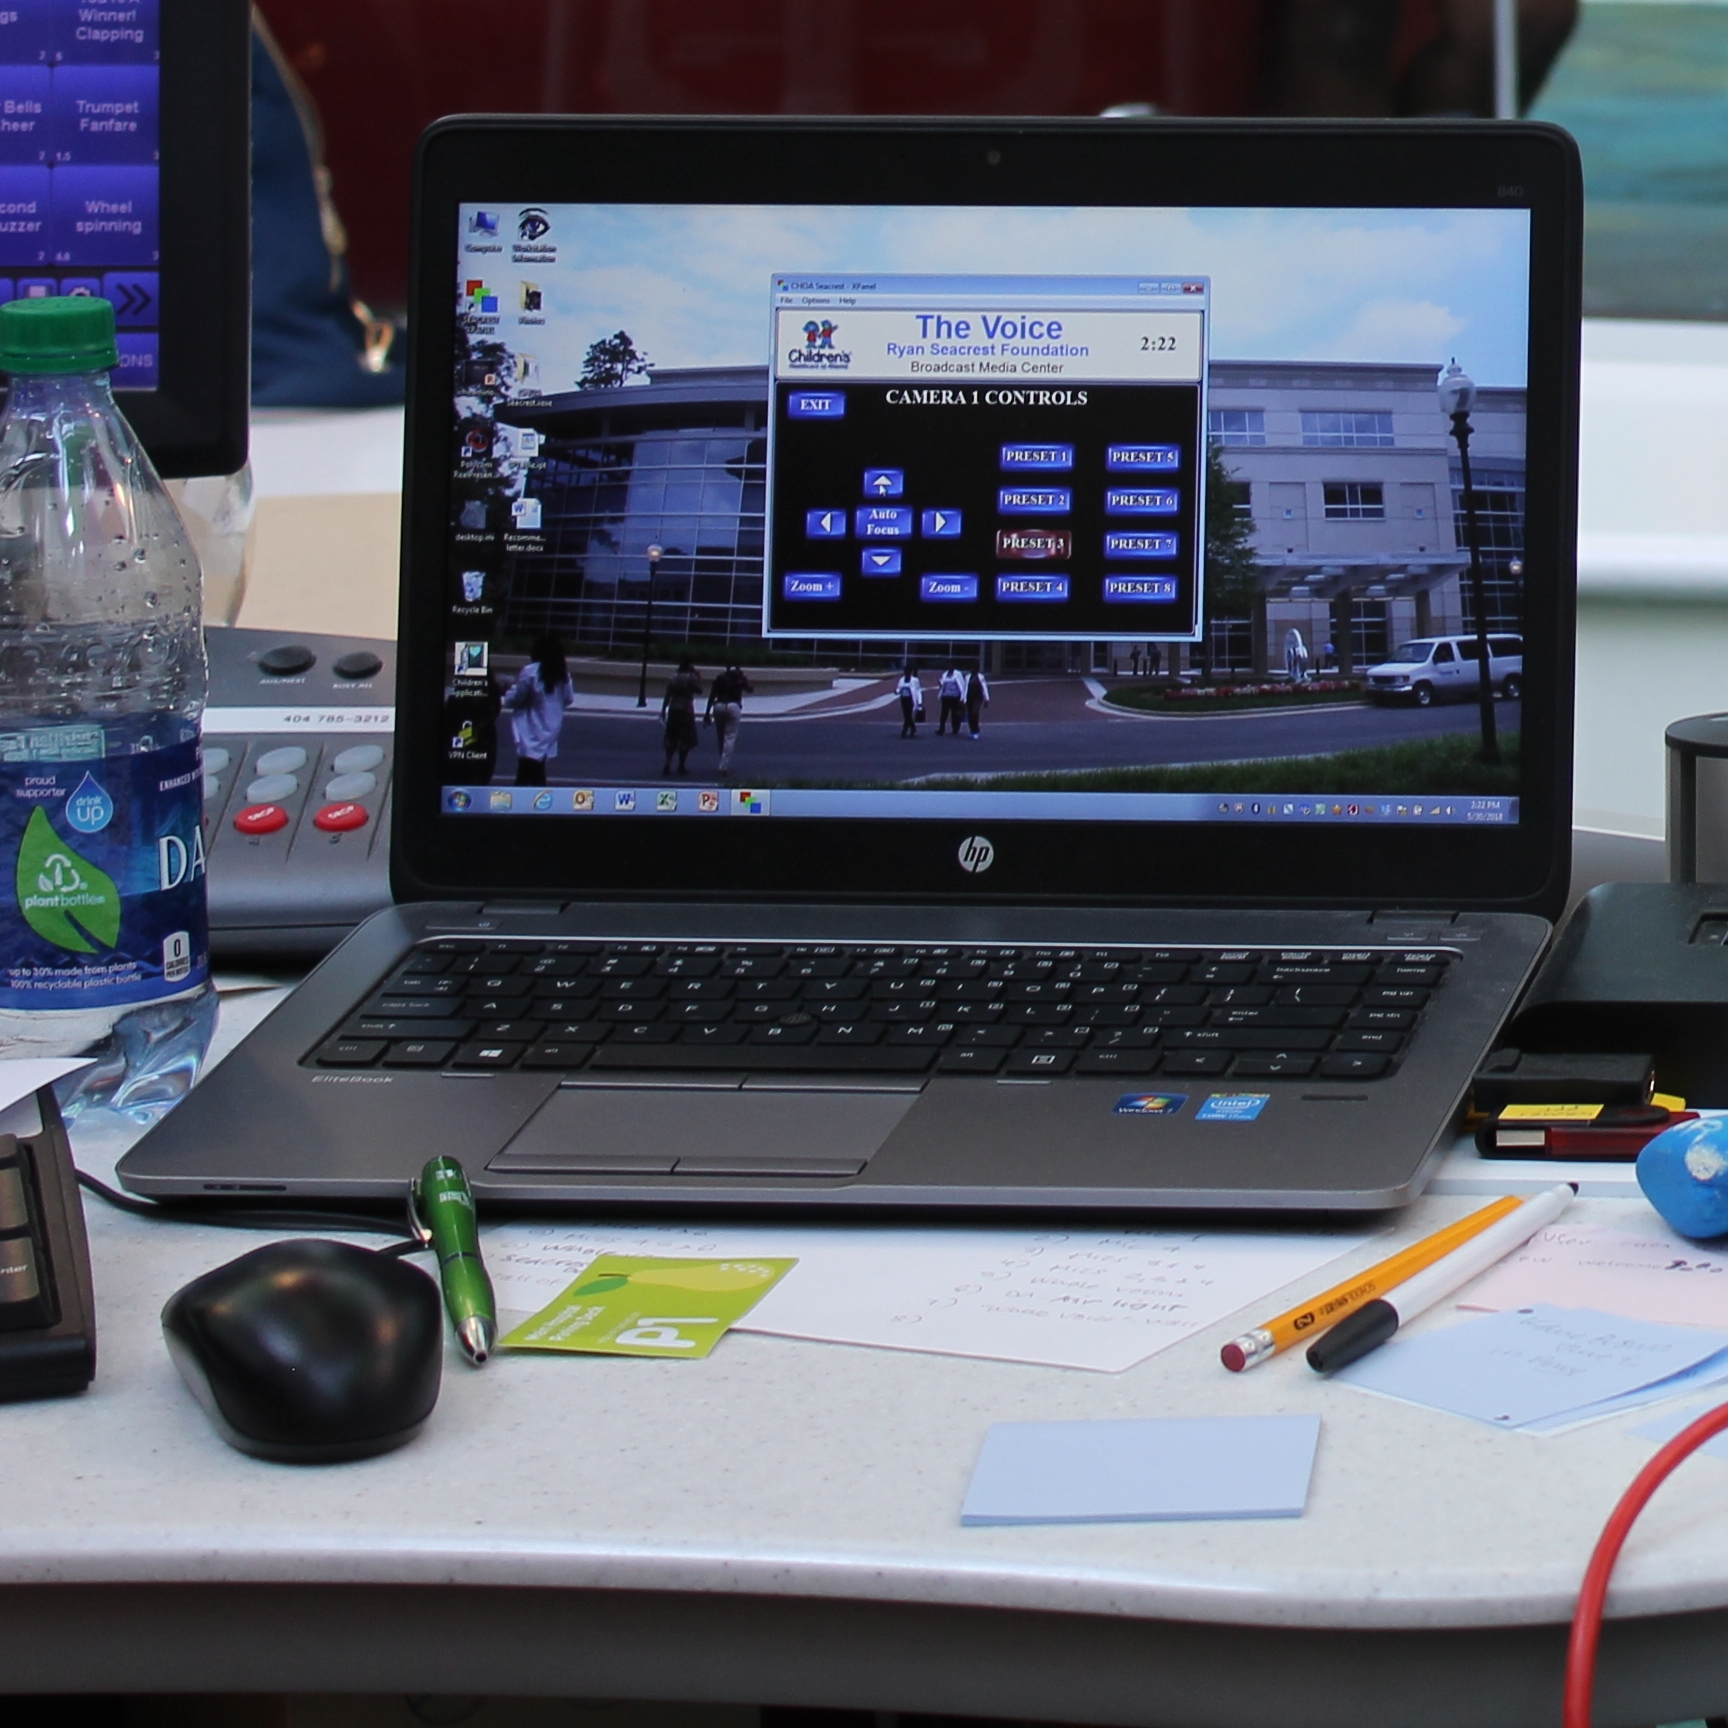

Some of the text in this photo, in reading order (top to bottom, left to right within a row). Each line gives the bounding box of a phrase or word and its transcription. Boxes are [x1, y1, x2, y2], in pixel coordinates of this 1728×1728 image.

[78, 9, 137, 22] Winner!
[75, 27, 144, 43] Clapping
[5, 101, 41, 113] Bells
[76, 101, 139, 116] Trumpet
[80, 119, 137, 131] Fanfare
[86, 201, 132, 213] Wheel
[76, 221, 141, 234] spinning
[801, 297, 830, 305] Options
[839, 297, 856, 305] Help
[916, 315, 1063, 339] The Voice
[1140, 336, 1177, 352] 2:22
[887, 342, 1089, 359] Ryan Seacrest Foundation
[911, 361, 1064, 374] Broadcast Media Center
[885, 389, 1088, 406] CAMERA 1 CONTROLS
[800, 399, 832, 411] EXIT
[1006, 450, 1068, 462] PRESET 1
[1113, 451, 1174, 463] PRESET 5
[1004, 494, 1065, 505] PRESET 2
[1111, 495, 1173, 506] PRESET 6
[869, 508, 897, 520] Auto
[866, 524, 900, 535] Focus
[1002, 537, 1065, 549] PRESET 3
[1110, 539, 1172, 550] PRESET 7
[791, 581, 834, 592] Zoom +
[928, 582, 961, 593] Zoom
[1001, 581, 1063, 592] PRESET 4
[1109, 582, 1171, 594] PRESET 8
[481, 606, 493, 614] Bin
[283, 714, 311, 723] 404
[466, 751, 487, 759] Client
[25, 776, 56, 789] proud
[16, 787, 67, 798] supporter
[76, 796, 102, 806] drink
[960, 837, 992, 873] hp
[174, 939, 181, 957] 0
[10, 961, 137, 977] up to 30% made from plants
[11, 973, 141, 991] 100% recyclable plastic bottle
[312, 1074, 394, 1083] EliteBook
[615, 1316, 719, 1349] P1
